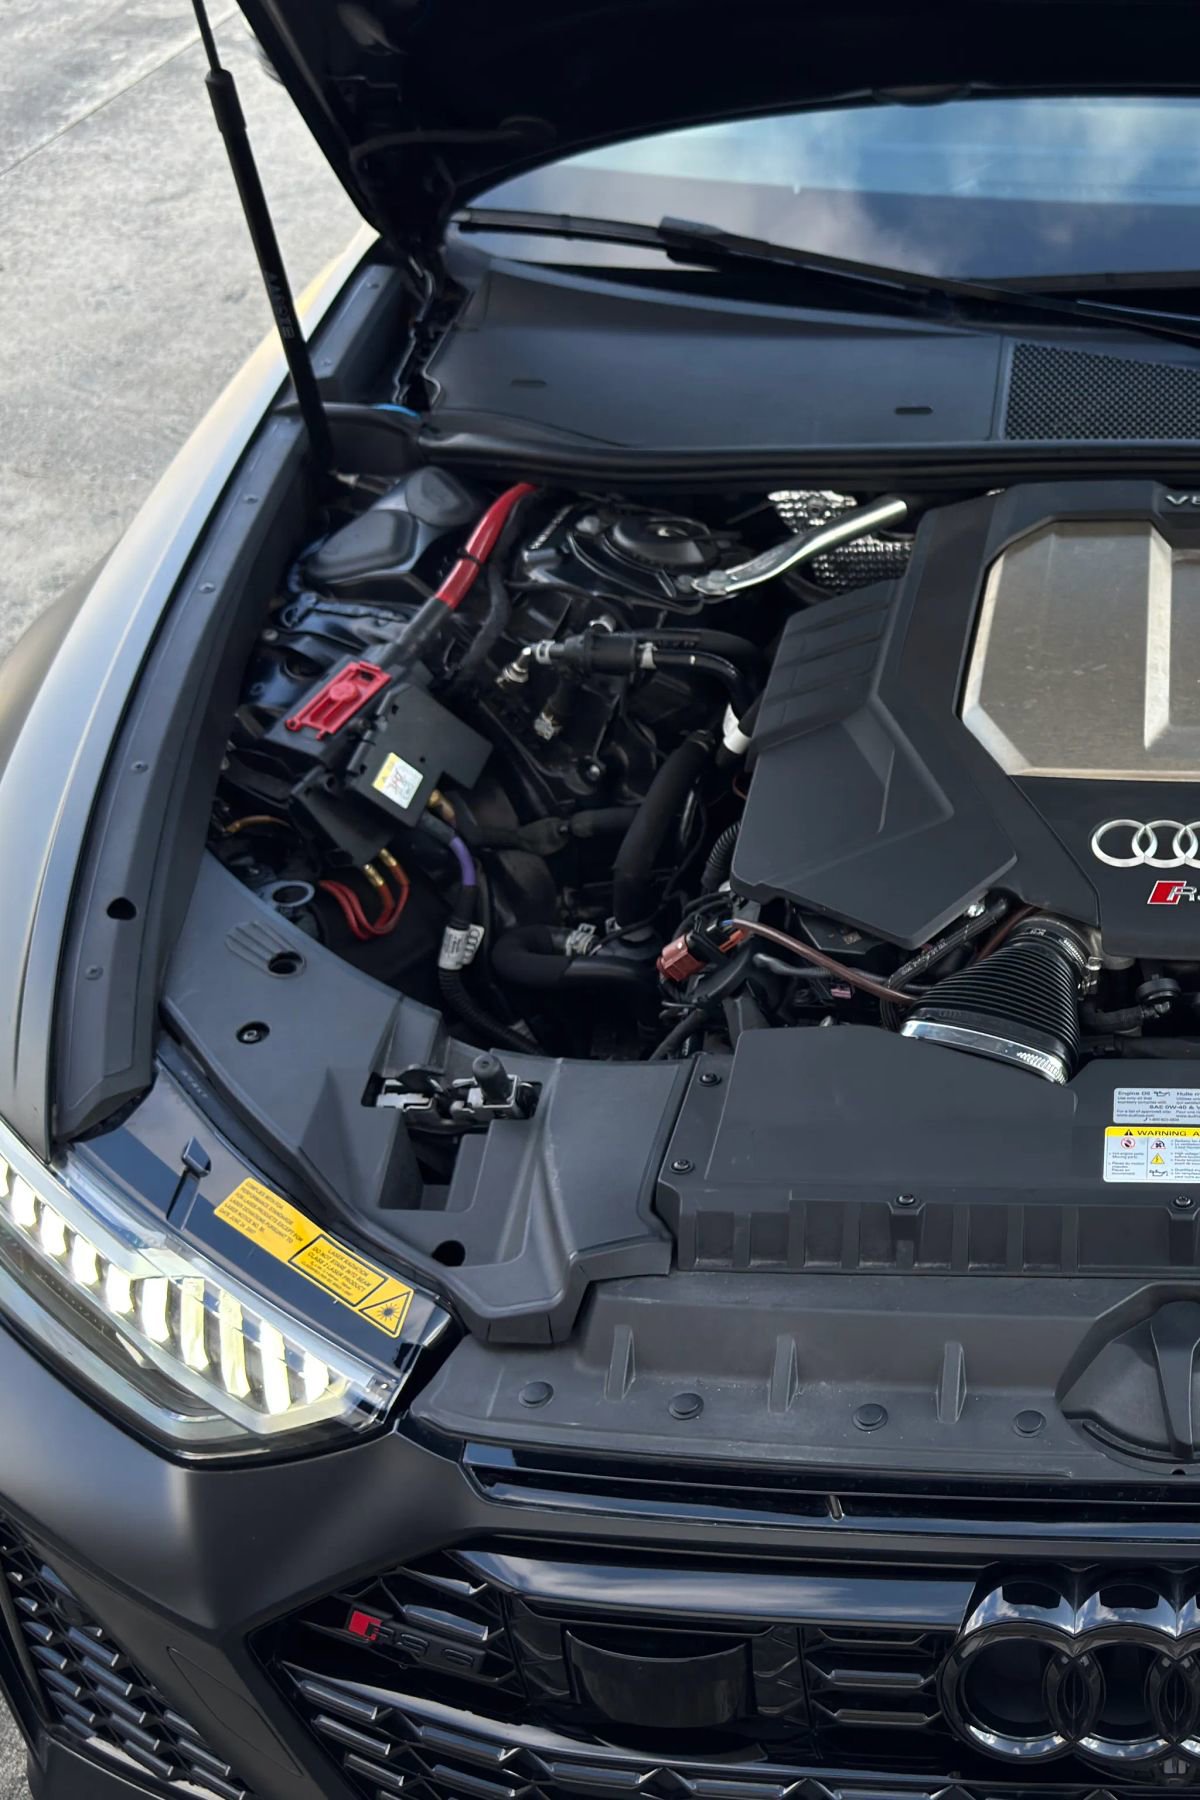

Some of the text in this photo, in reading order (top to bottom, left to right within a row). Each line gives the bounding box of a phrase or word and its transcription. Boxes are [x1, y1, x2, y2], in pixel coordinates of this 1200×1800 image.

[307, 1251, 324, 1265] CLASS
[326, 1264, 343, 1278] LASER
[342, 1275, 366, 1293] PRODUCT
[313, 1246, 321, 1255] DO
[321, 1252, 331, 1261] NOT
[357, 1276, 372, 1288] BEAM
[328, 1249, 344, 1261] LASER
